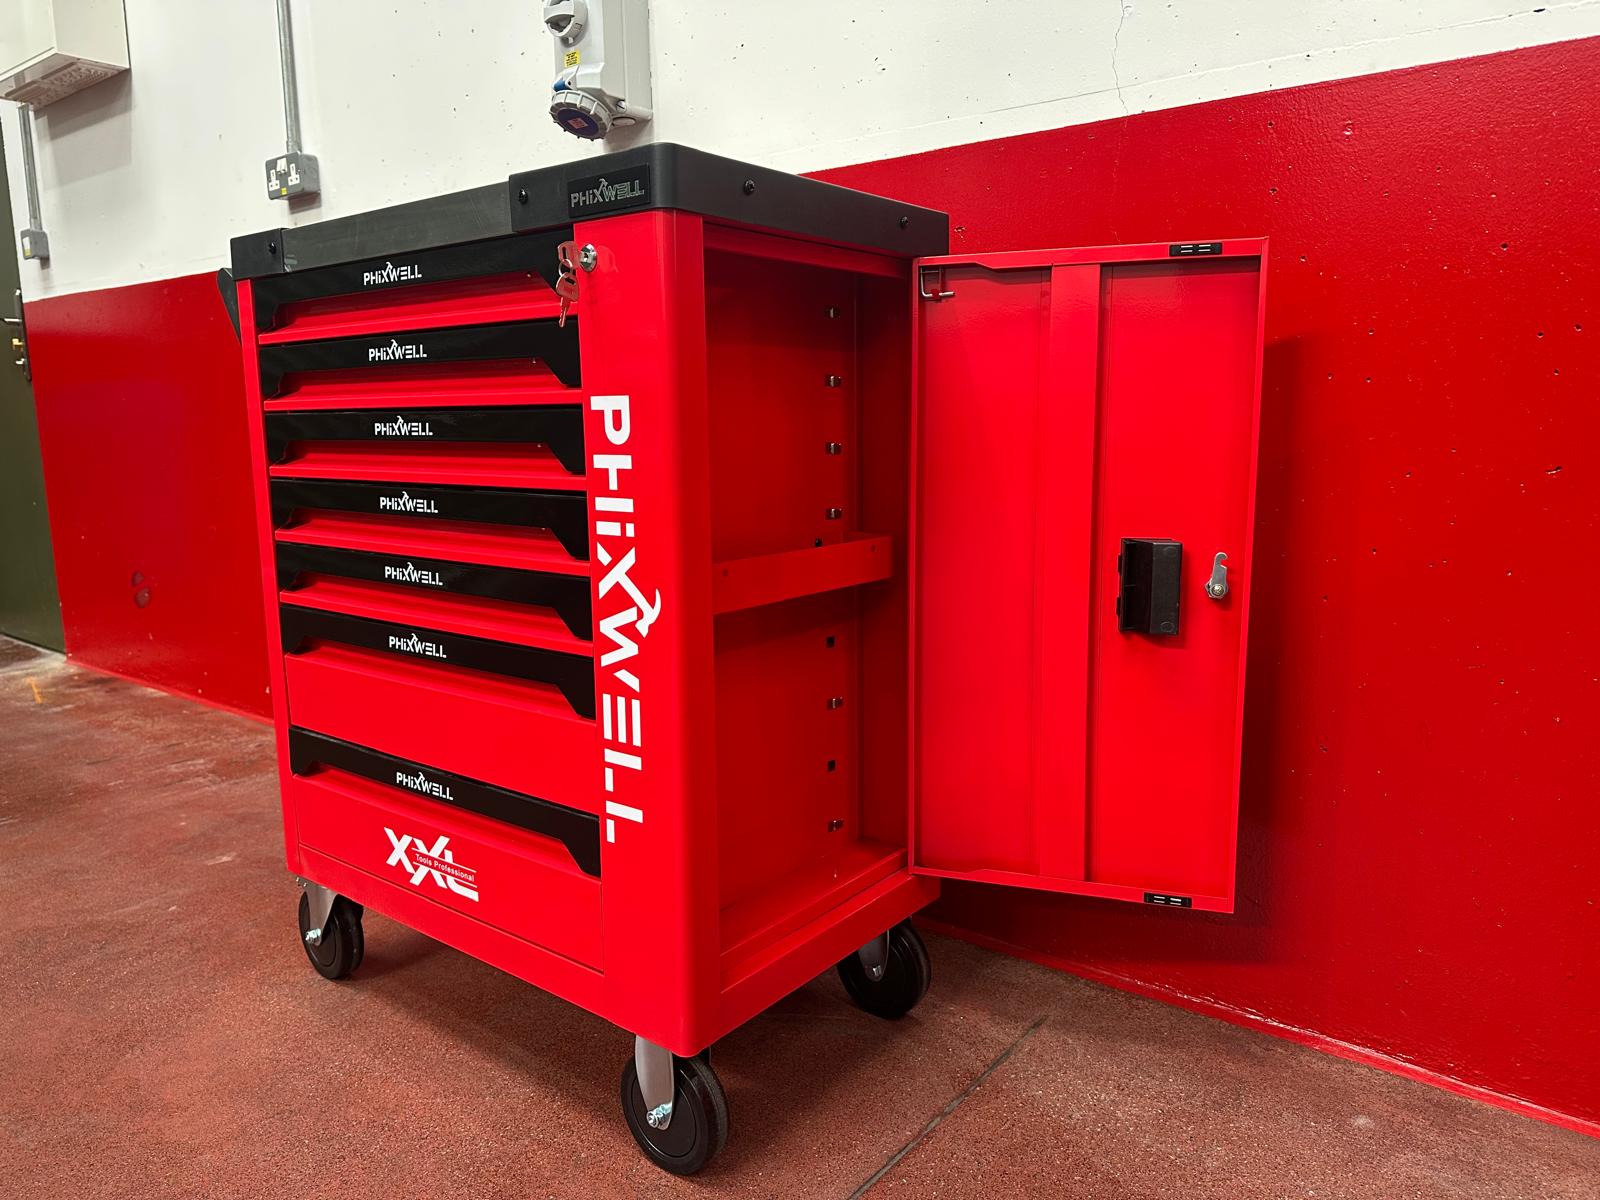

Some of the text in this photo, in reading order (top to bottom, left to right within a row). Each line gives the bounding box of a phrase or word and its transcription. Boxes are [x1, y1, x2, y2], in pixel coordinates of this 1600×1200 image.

[571, 178, 645, 208] PHiXWELL
[363, 261, 423, 286] PHiXWELL
[368, 339, 428, 362] PHiXWELL
[374, 415, 434, 436] PHiXWELL
[379, 491, 439, 514] PHiXWELL
[384, 562, 444, 586] PHiXWELL
[590, 394, 662, 843] PHiXWELL
[388, 633, 447, 659] PHiXWELL
[396, 771, 454, 801] PHiXWELL
[383, 826, 480, 903] XXL
[415, 853, 475, 883] Tools Professional
